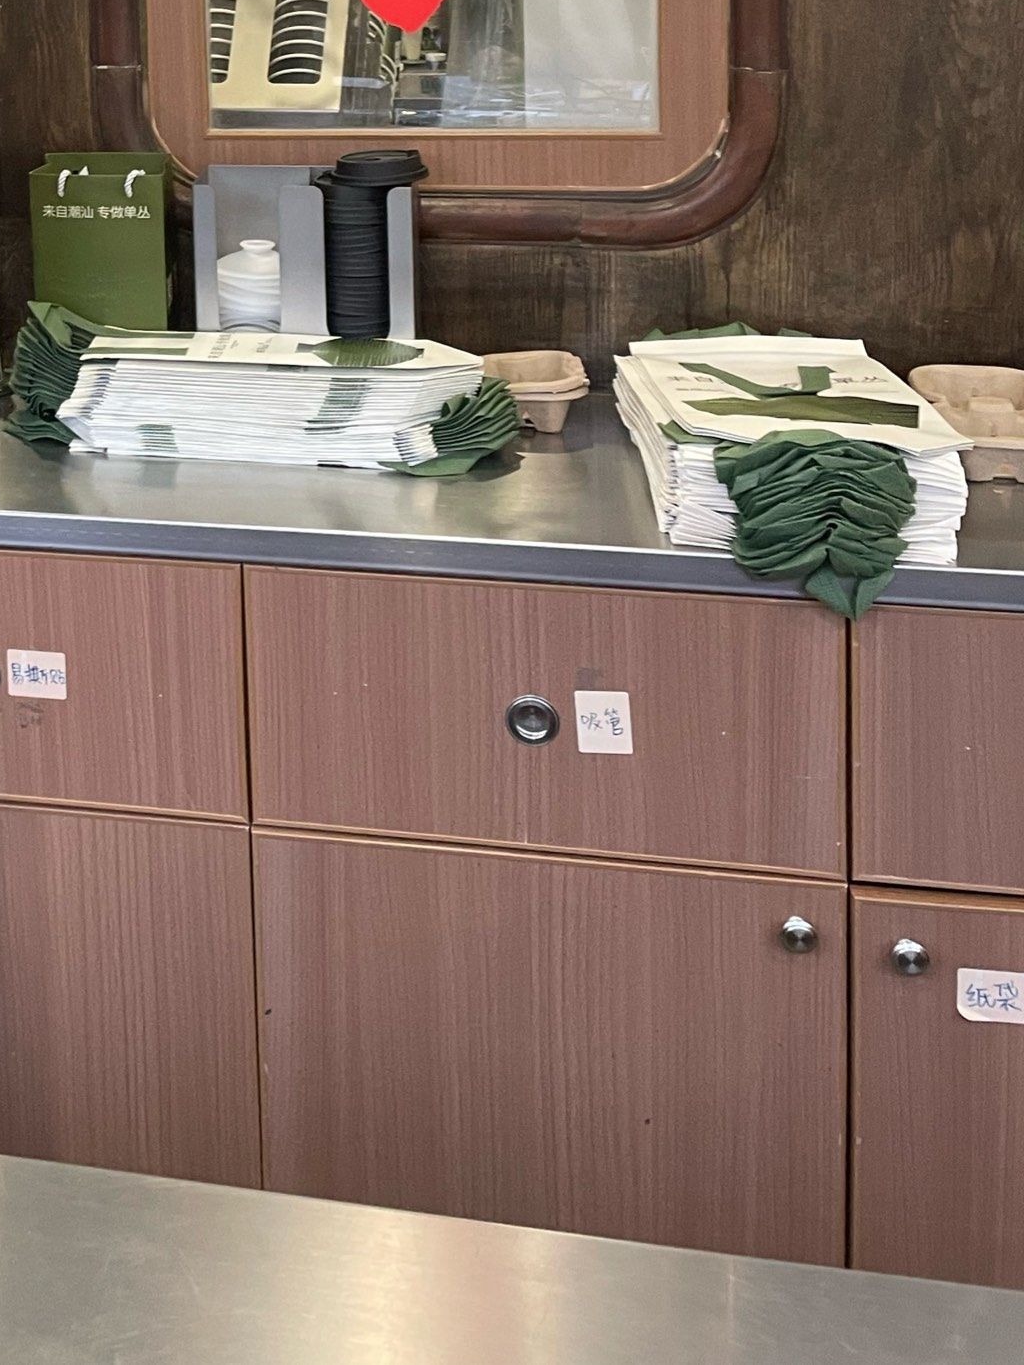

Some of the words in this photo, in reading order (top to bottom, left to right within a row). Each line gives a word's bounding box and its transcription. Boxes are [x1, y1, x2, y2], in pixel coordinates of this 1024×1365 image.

[42, 205, 94, 219] 来自潮汕
[97, 205, 151, 219] 专做单丛
[580, 707, 624, 736] 吸管
[966, 980, 1022, 1011] 纸袋
